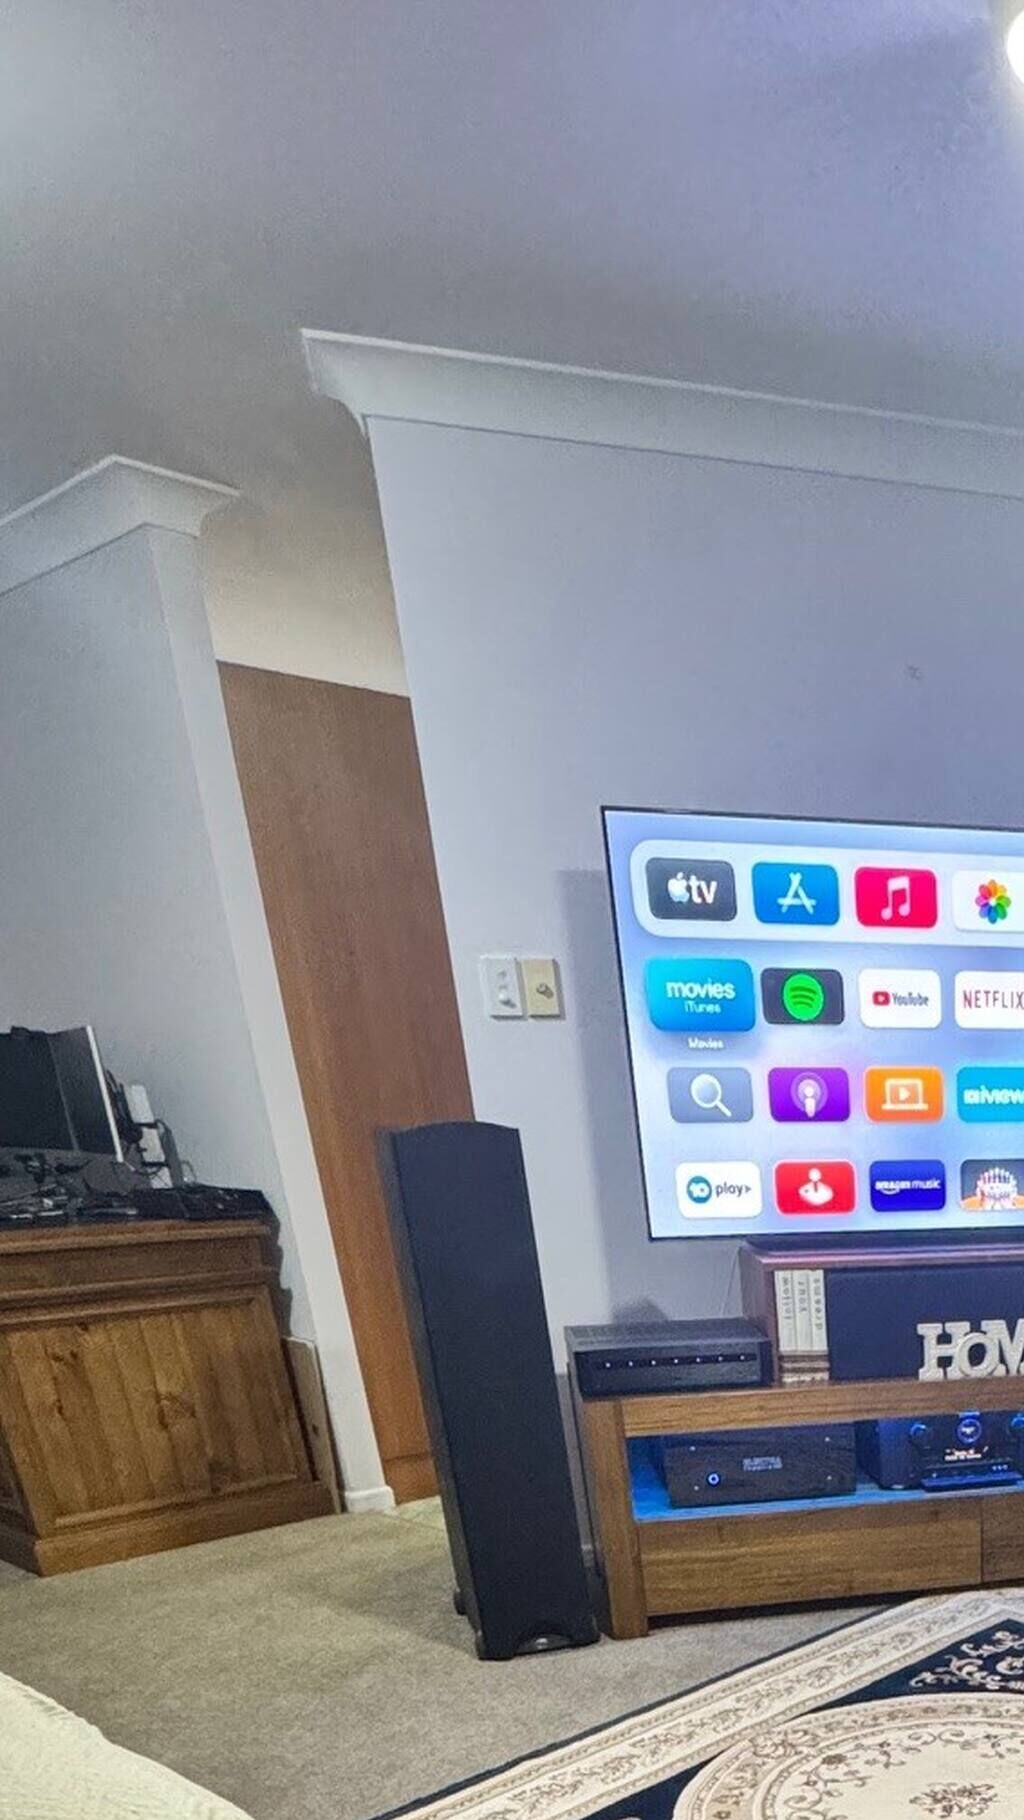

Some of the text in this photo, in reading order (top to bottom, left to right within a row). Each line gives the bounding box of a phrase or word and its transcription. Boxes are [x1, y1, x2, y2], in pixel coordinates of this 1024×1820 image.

[689, 875, 717, 904] tv
[665, 978, 736, 1000] movies
[684, 1002, 721, 1014] iTunes
[893, 992, 929, 1007] YouTube
[963, 990, 1024, 1010] NETFLIX
[911, 1178, 941, 1190] music
